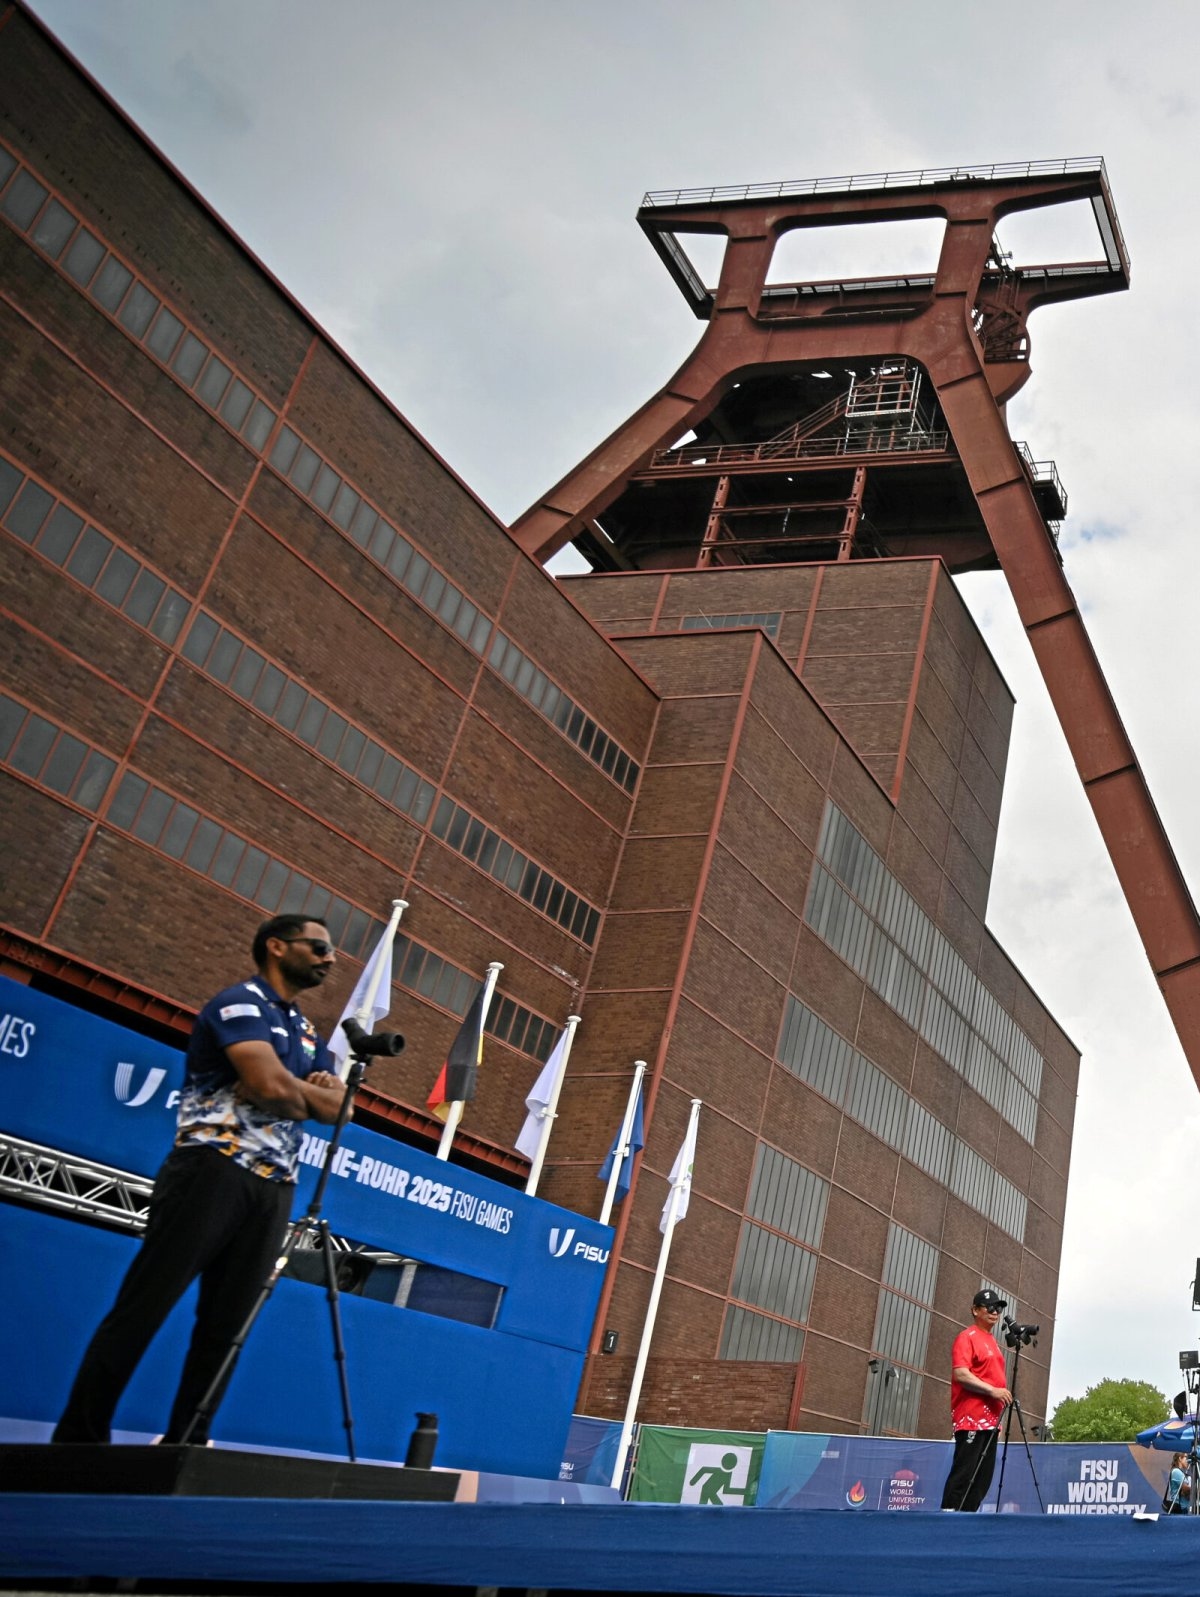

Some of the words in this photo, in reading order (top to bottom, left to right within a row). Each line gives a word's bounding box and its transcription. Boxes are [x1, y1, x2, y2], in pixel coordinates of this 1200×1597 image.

[407, 1175, 454, 1213] 2025
[450, 1190, 477, 1222] FISU
[475, 1199, 514, 1235] GAMES
[573, 1242, 610, 1264] FISU
[1081, 1460, 1119, 1481] FISU
[889, 1488, 914, 1496] WORLD
[1068, 1482, 1129, 1503] WORLD
